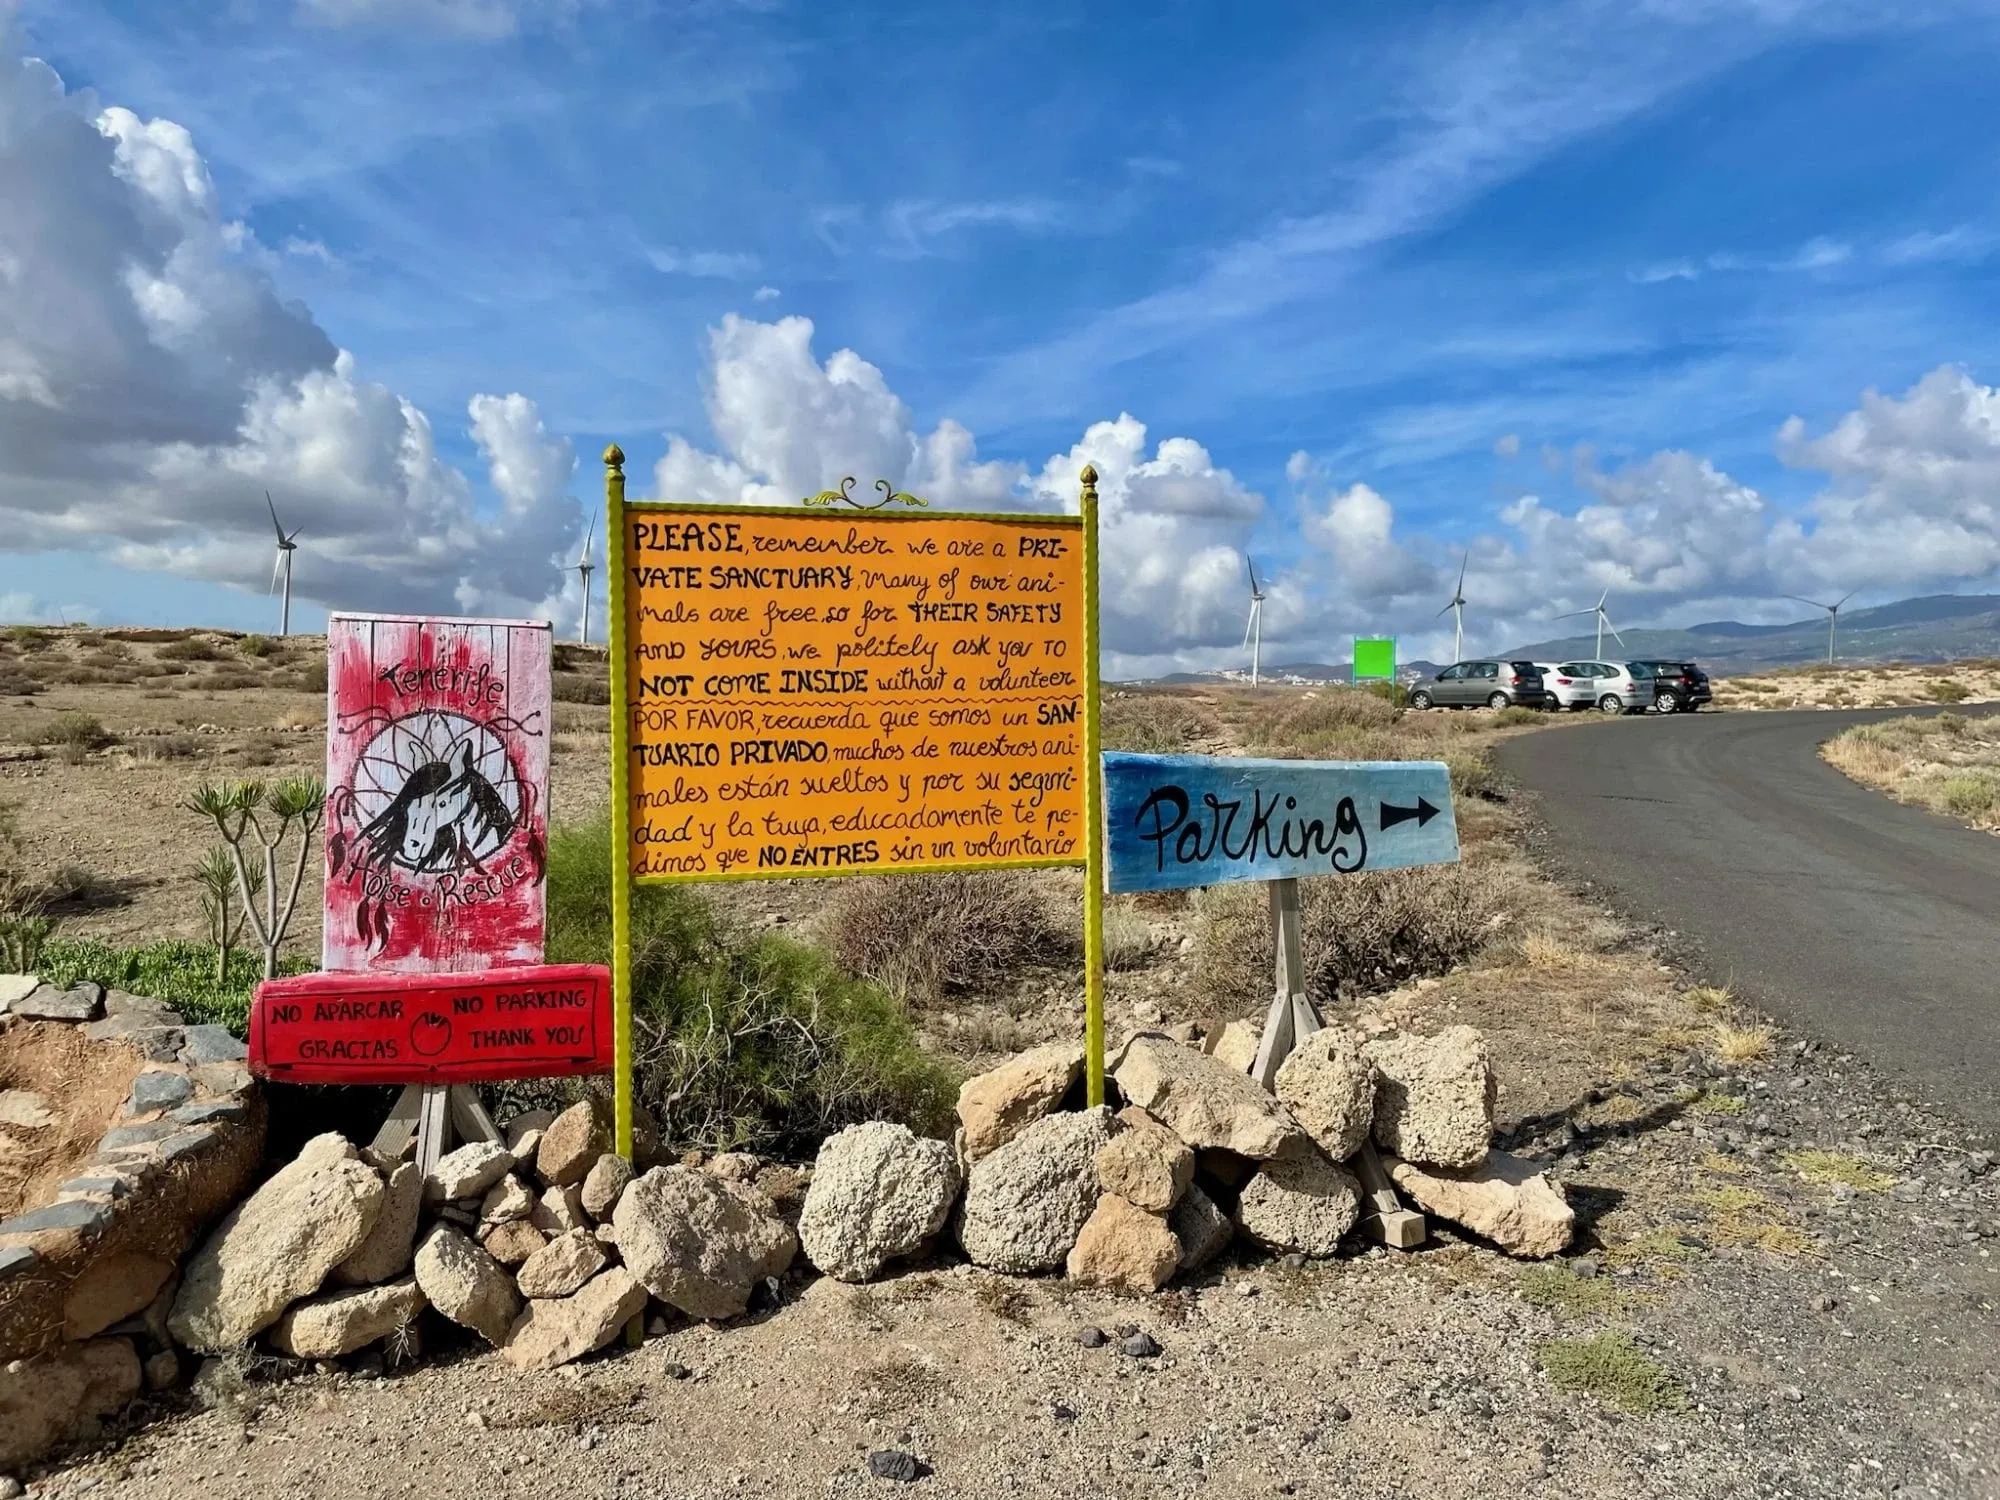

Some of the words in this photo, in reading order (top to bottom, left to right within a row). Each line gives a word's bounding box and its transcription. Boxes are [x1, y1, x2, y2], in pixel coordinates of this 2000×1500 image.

[752, 528, 893, 554] remember
[908, 540, 939, 556] we
[947, 540, 984, 557] are
[992, 543, 1006, 557] a
[1018, 536, 1068, 558] PRI-
[633, 566, 701, 589] VATE
[938, 567, 960, 599] of
[970, 574, 1011, 591] our
[1017, 572, 1065, 592] ani-
[636, 603, 699, 623] mals
[710, 606, 749, 621] are
[855, 602, 897, 636] for
[908, 601, 977, 622] THEIR
[986, 603, 1062, 624] SAFETY
[788, 645, 821, 659] we
[836, 635, 939, 672] politely
[953, 636, 991, 654] ask
[998, 641, 1031, 667] you
[1044, 640, 1065, 657] TO
[378, 663, 504, 706] Tenerife
[638, 675, 693, 696] NOT
[779, 669, 868, 693] INSIDE
[876, 667, 947, 692] without
[954, 676, 964, 690] a
[980, 666, 1076, 690] volunteer
[633, 709, 677, 732] POR
[880, 709, 919, 736] que
[929, 709, 991, 730] somos
[1002, 712, 1028, 727] un
[633, 742, 720, 767] TUARIO
[834, 739, 903, 761] muchos
[911, 736, 939, 758] de
[948, 734, 1037, 757] nuestros
[1042, 733, 1080, 755] ani-
[635, 777, 709, 809] males
[718, 774, 788, 802] están
[800, 766, 888, 795] sueltos
[898, 775, 911, 802] y
[922, 775, 964, 802] por
[976, 772, 1001, 790] su
[634, 814, 692, 844] dad
[699, 821, 714, 848] y
[727, 811, 754, 838] la
[829, 804, 1002, 834] educadamente
[1014, 799, 1035, 824] te
[633, 849, 706, 874] dimos
[716, 847, 750, 871] que
[758, 847, 787, 867] NO
[790, 841, 879, 866] ENTRES
[890, 836, 924, 862] sin
[932, 841, 956, 858] un
[964, 829, 1076, 856] voluntario
[436, 855, 530, 907] Rescue
[270, 1005, 302, 1024] NO
[313, 1000, 405, 1019] APARCAR
[452, 996, 483, 1015] NO
[496, 990, 587, 1010] PARKING
[299, 1040, 398, 1060] GRACIAS
[469, 1028, 535, 1048] THANK
[545, 1026, 586, 1045] YOU
